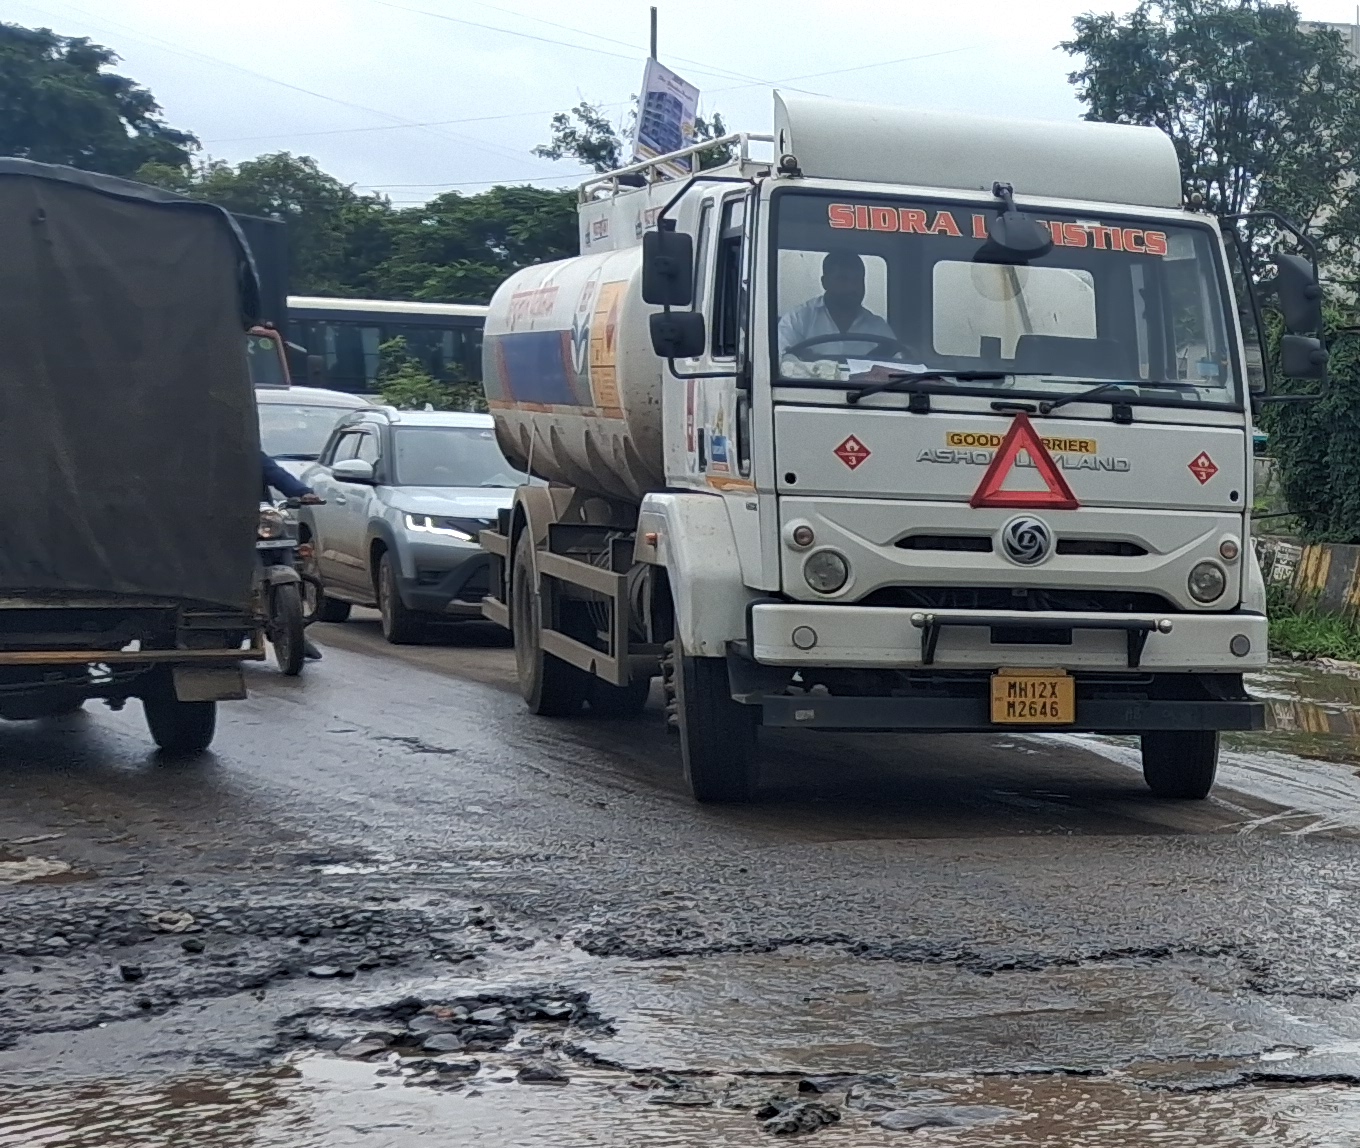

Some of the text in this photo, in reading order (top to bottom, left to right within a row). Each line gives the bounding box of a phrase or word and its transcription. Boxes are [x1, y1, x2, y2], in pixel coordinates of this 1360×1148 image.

[828, 203, 1168, 256] SIDRA LISTICS
[951, 433, 1006, 448] GOOD
[1042, 438, 1090, 452] RRIER
[848, 456, 857, 466] 3
[916, 448, 997, 465] ASHO
[1199, 471, 1207, 480] 3
[1007, 681, 1058, 699] MH12X
[1006, 700, 1059, 718] M2646
